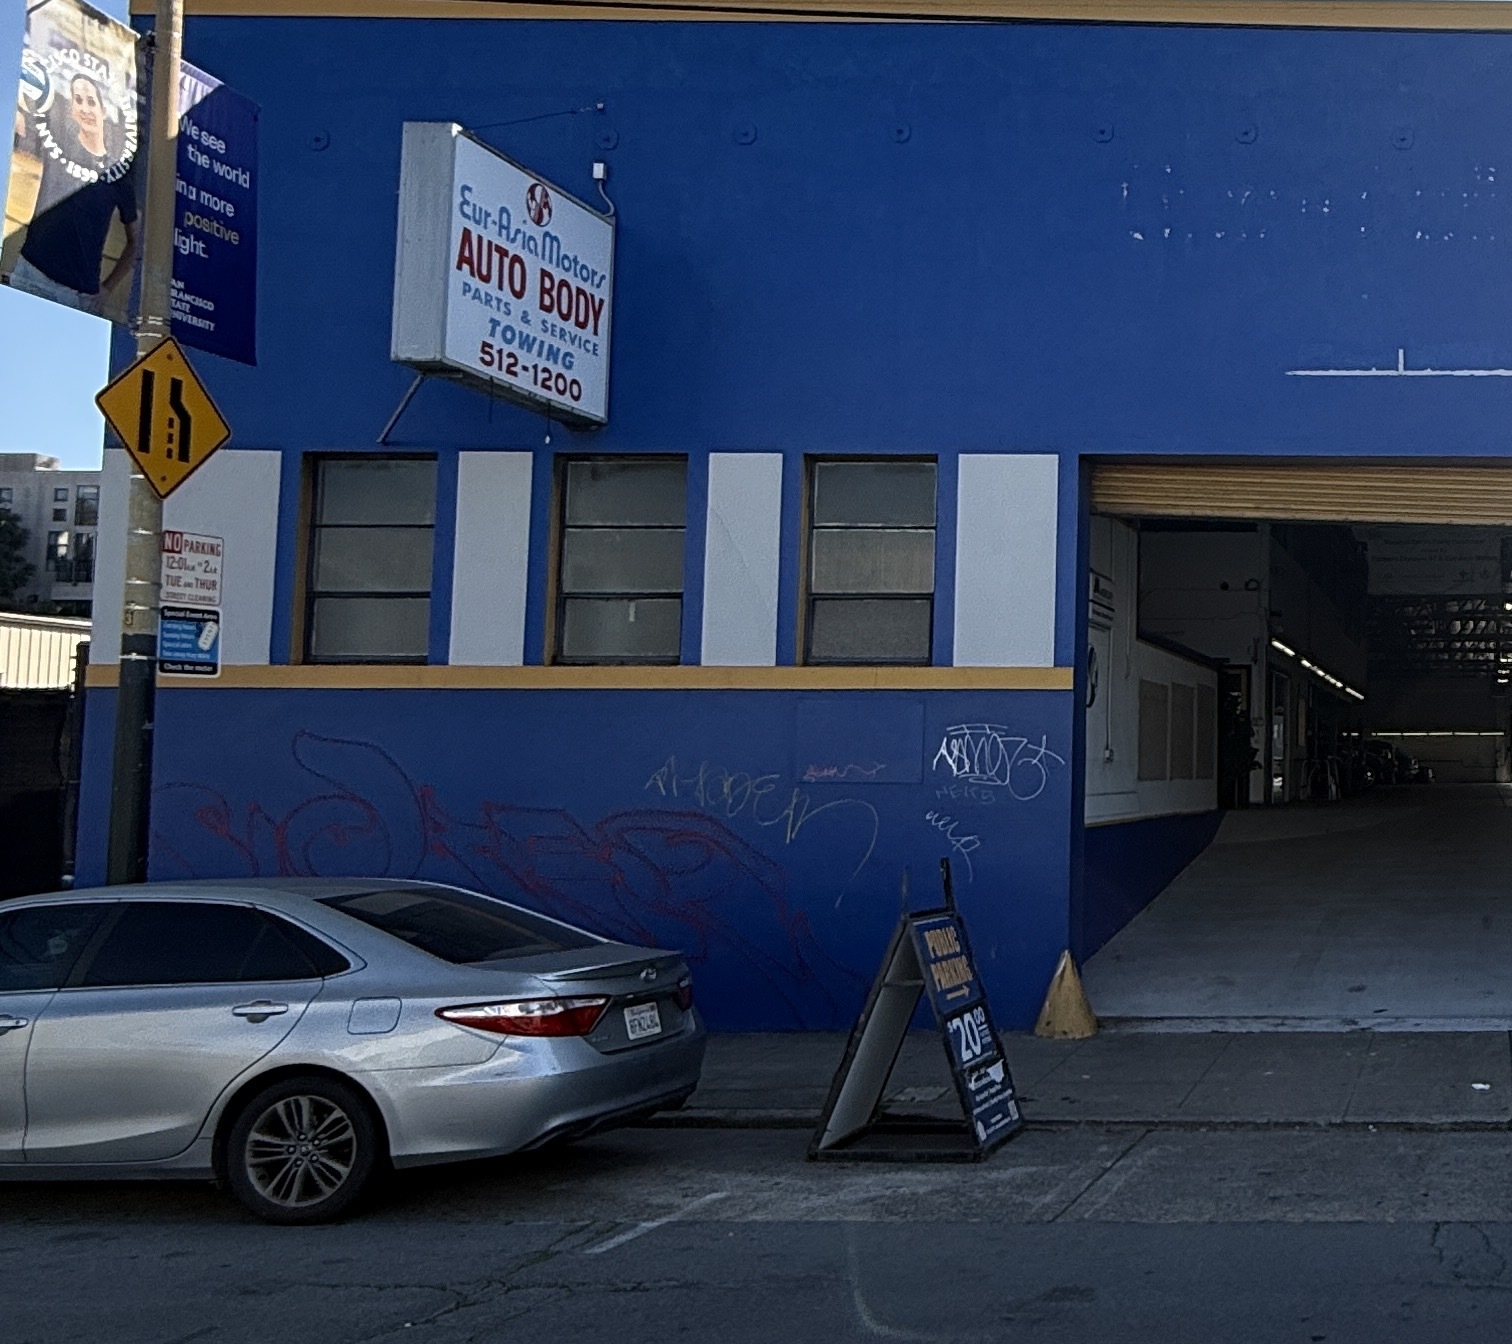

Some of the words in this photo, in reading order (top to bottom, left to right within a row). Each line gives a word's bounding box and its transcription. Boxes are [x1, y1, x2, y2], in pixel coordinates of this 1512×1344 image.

[180, 115, 200, 139] We
[200, 130, 226, 154] see
[187, 143, 210, 169] the
[212, 159, 250, 189] world
[200, 189, 235, 218] more
[183, 210, 240, 245] positive
[541, 231, 607, 289] Motors
[170, 288, 215, 311] RANCISCO
[171, 278, 185, 290] AN
[456, 226, 527, 300] AUTO
[539, 267, 604, 336] BODY
[171, 298, 191, 313] TATE
[462, 282, 512, 316] PARTS
[520, 310, 531, 326] &
[541, 318, 599, 356] SERVICE
[489, 318, 575, 371] TOWING
[479, 340, 582, 402] 512-1200
[164, 532, 181, 552] NO
[184, 539, 221, 557] PARKING
[165, 574, 182, 588] TUE
